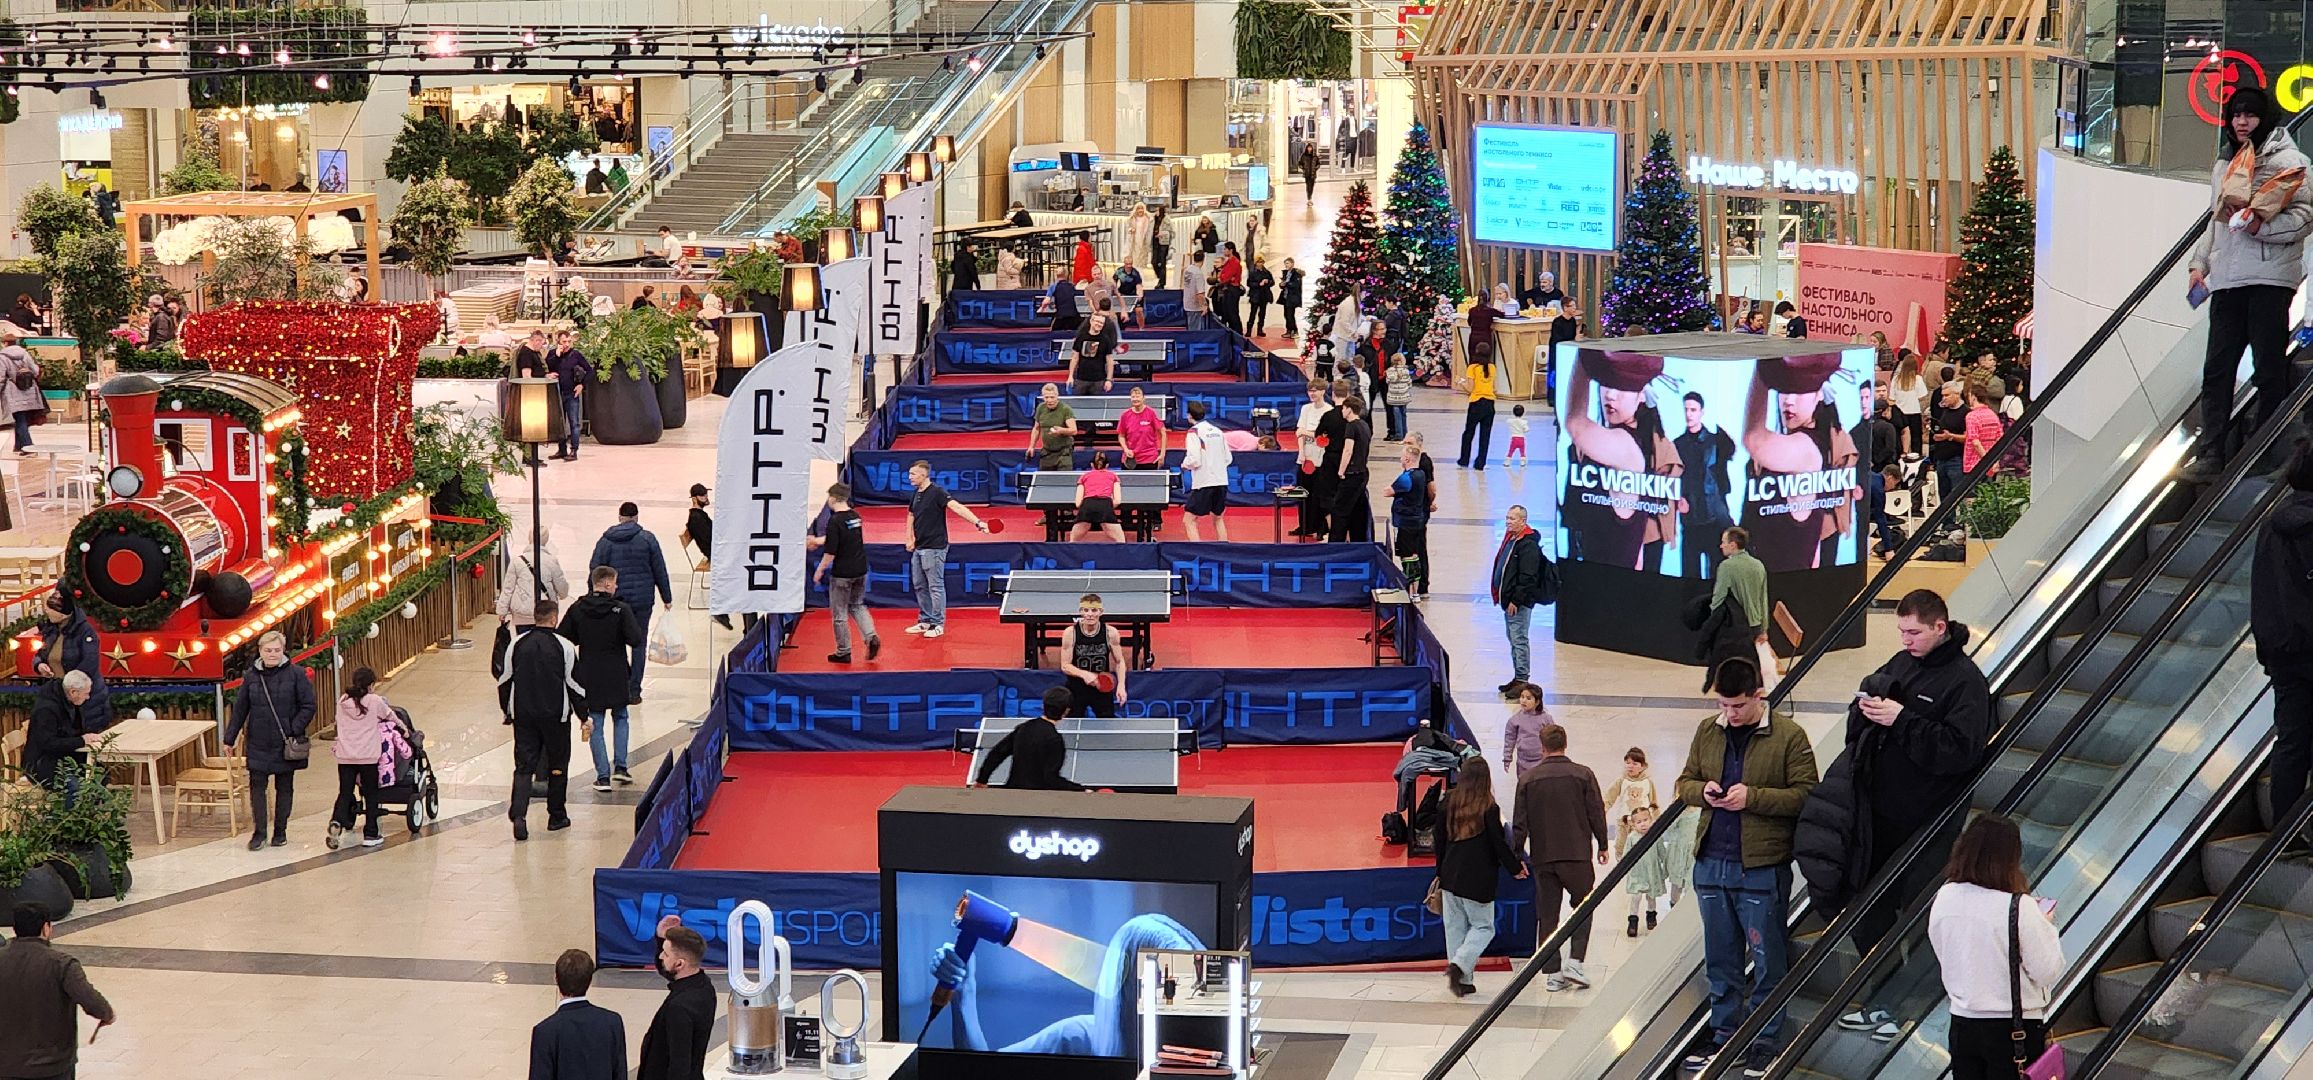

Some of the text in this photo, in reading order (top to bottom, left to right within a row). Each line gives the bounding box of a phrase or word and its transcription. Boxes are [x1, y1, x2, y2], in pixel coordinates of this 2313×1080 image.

[1689, 156, 1859, 194] Наше Место
[1802, 285, 1876, 305] ФЕСТИВАЛЬ
[1801, 301, 1893, 324] НАСТОЛЬНОГО
[1570, 463, 1600, 489] LC
[1749, 477, 1776, 502] LC
[1581, 492, 1669, 515] СТИЛЬНО И ВЫГОДНО
[1759, 496, 1845, 517] СТИЛЬНО И ВЫГОДНО
[1224, 691, 1418, 728] НТР.
[1009, 830, 1101, 863] dyshop
